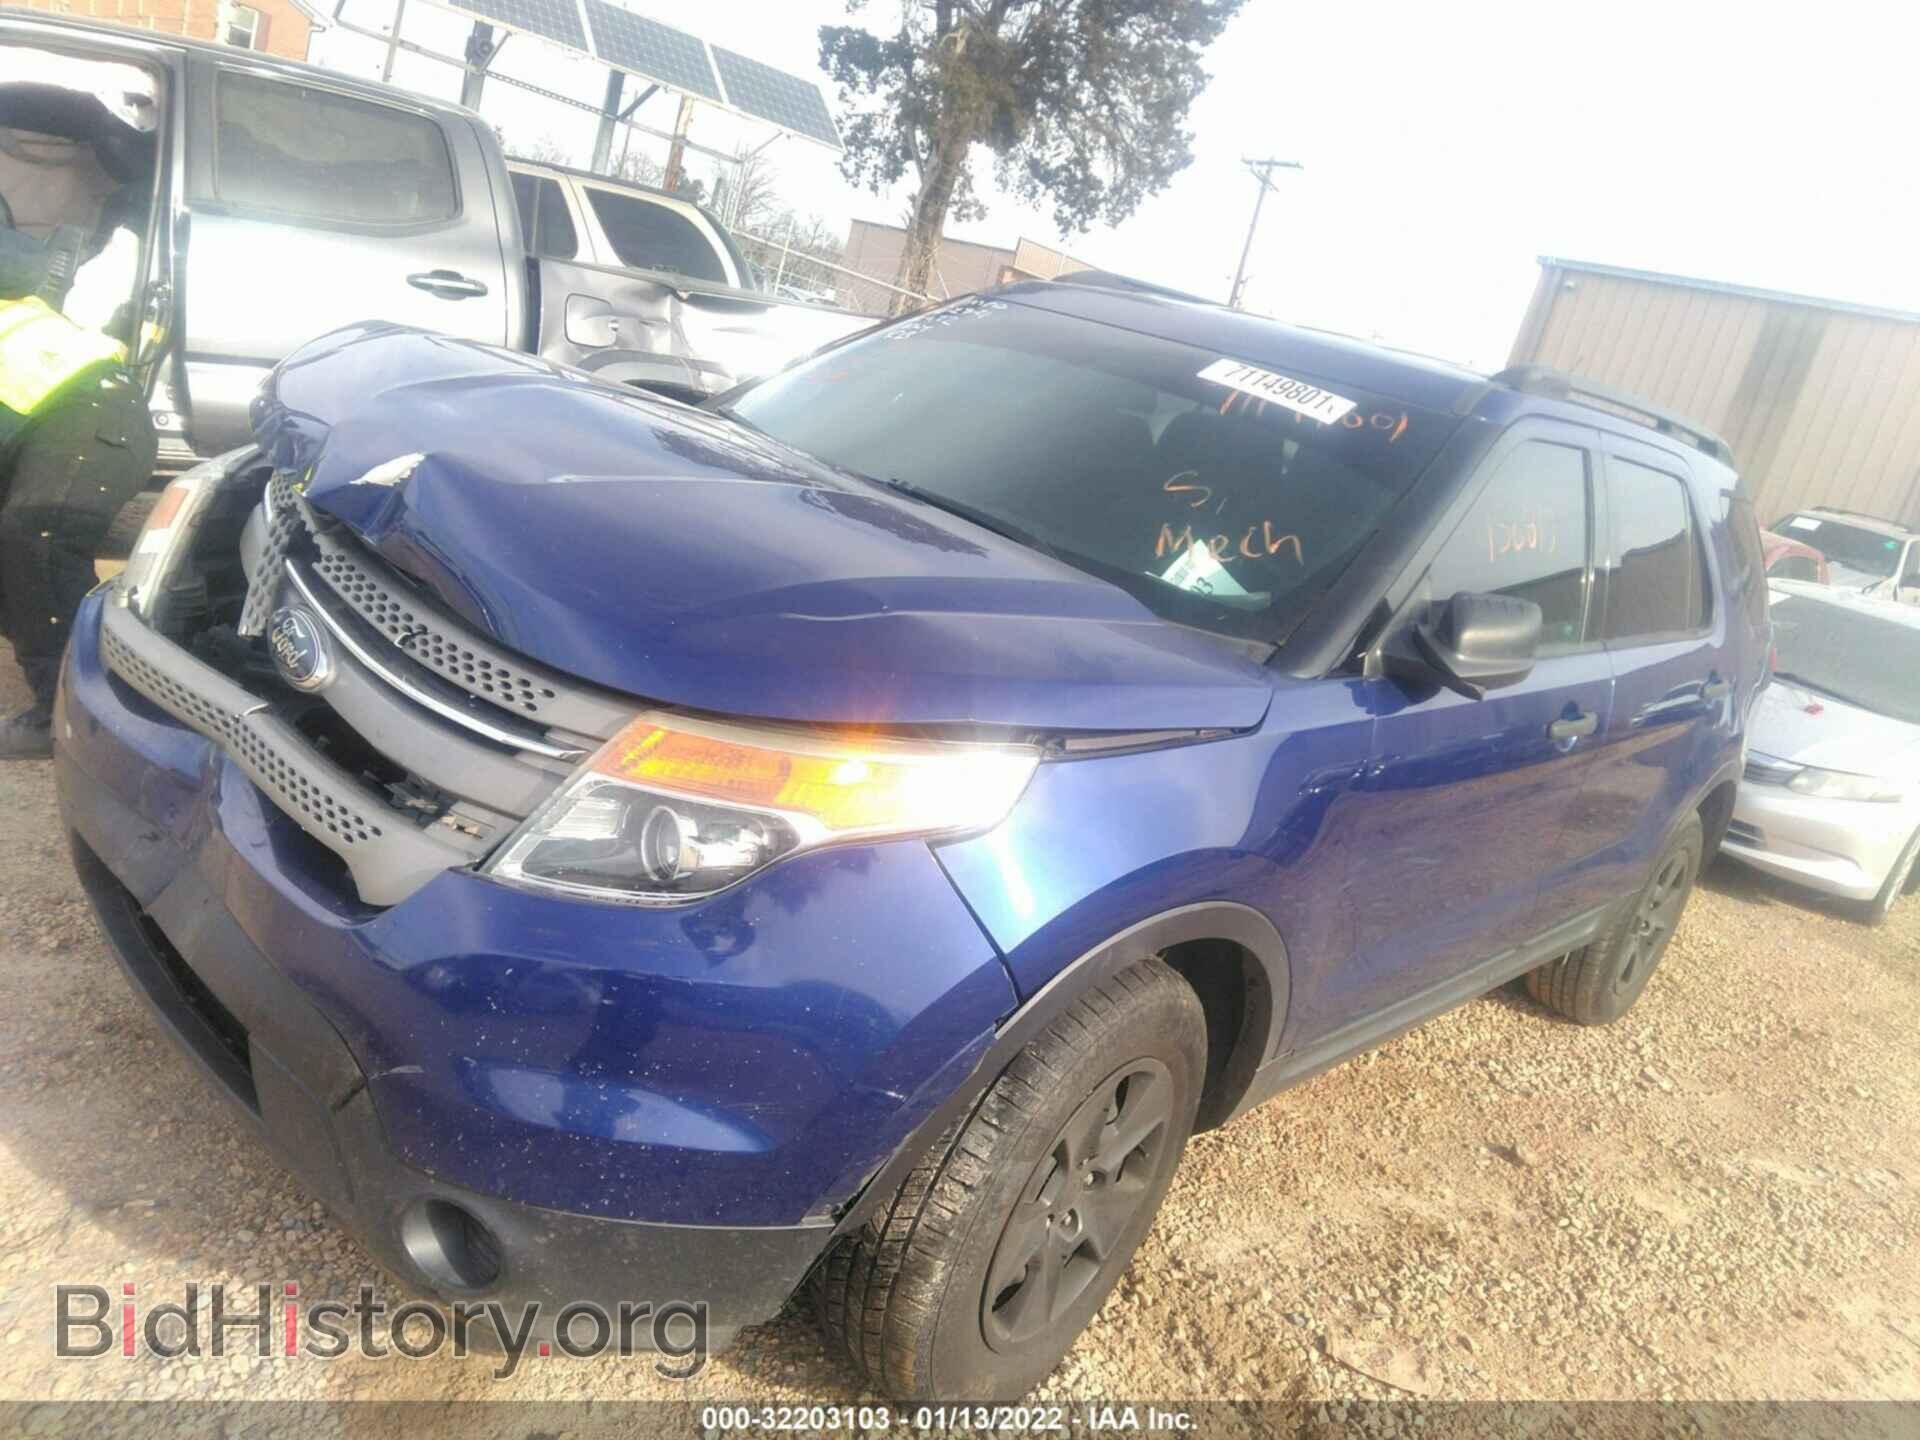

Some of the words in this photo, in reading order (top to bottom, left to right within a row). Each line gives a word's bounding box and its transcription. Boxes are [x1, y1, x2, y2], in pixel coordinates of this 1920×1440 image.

[1225, 364, 1333, 412] 71149801
[1154, 520, 1304, 567] Mech
[272, 617, 308, 668] Ford
